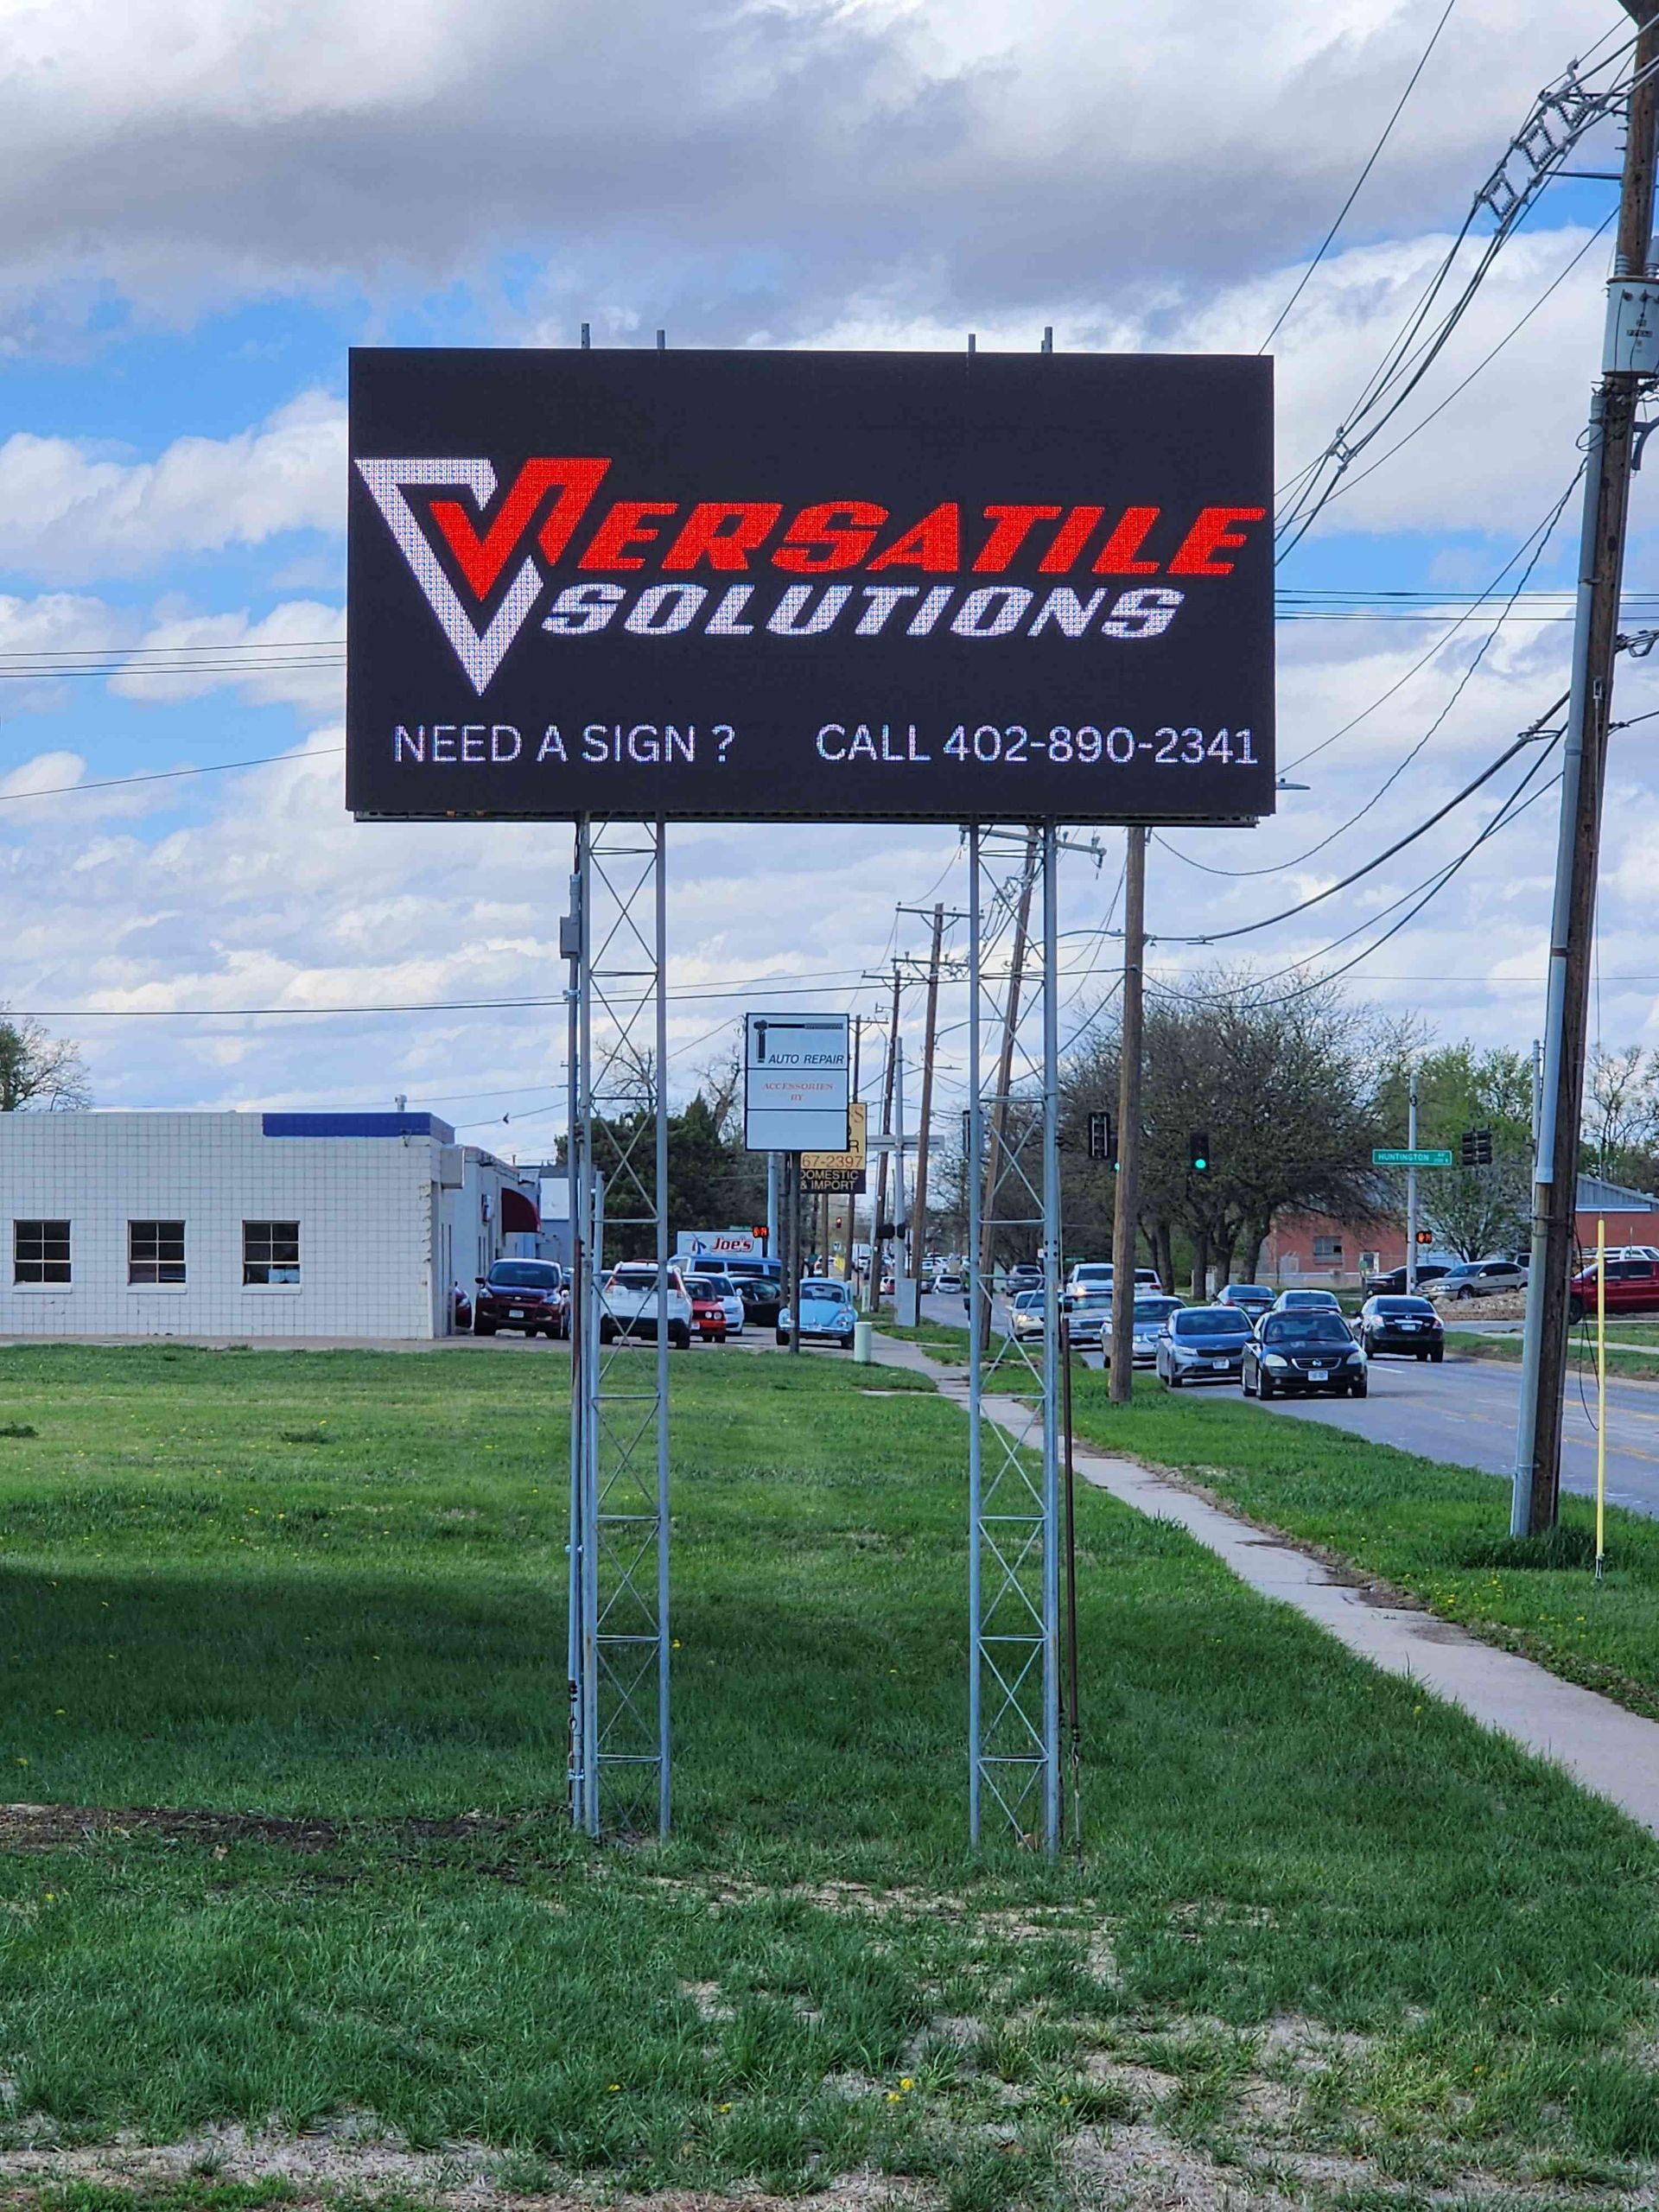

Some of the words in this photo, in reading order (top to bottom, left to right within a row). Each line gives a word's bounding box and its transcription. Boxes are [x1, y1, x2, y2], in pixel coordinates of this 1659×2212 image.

[429, 457, 1267, 601] VERSATILE
[541, 582, 1185, 639] SOLUTIONS
[394, 724, 522, 763] NEED
[536, 724, 569, 763] A
[582, 724, 696, 764] SIGN
[711, 724, 736, 763] ?
[816, 723, 932, 762] CALL
[943, 724, 1258, 766] 402-890-2341
[768, 1054, 800, 1065] AUTO
[804, 1054, 844, 1065] REPAIR
[762, 1082, 834, 1090] ACCESSORIES
[801, 1154, 863, 1168] 67-2397
[1377, 1153, 1430, 1162] HUNTINGTON
[810, 1180, 855, 1190] IMPORT
[712, 1236, 754, 1252] Joe's
